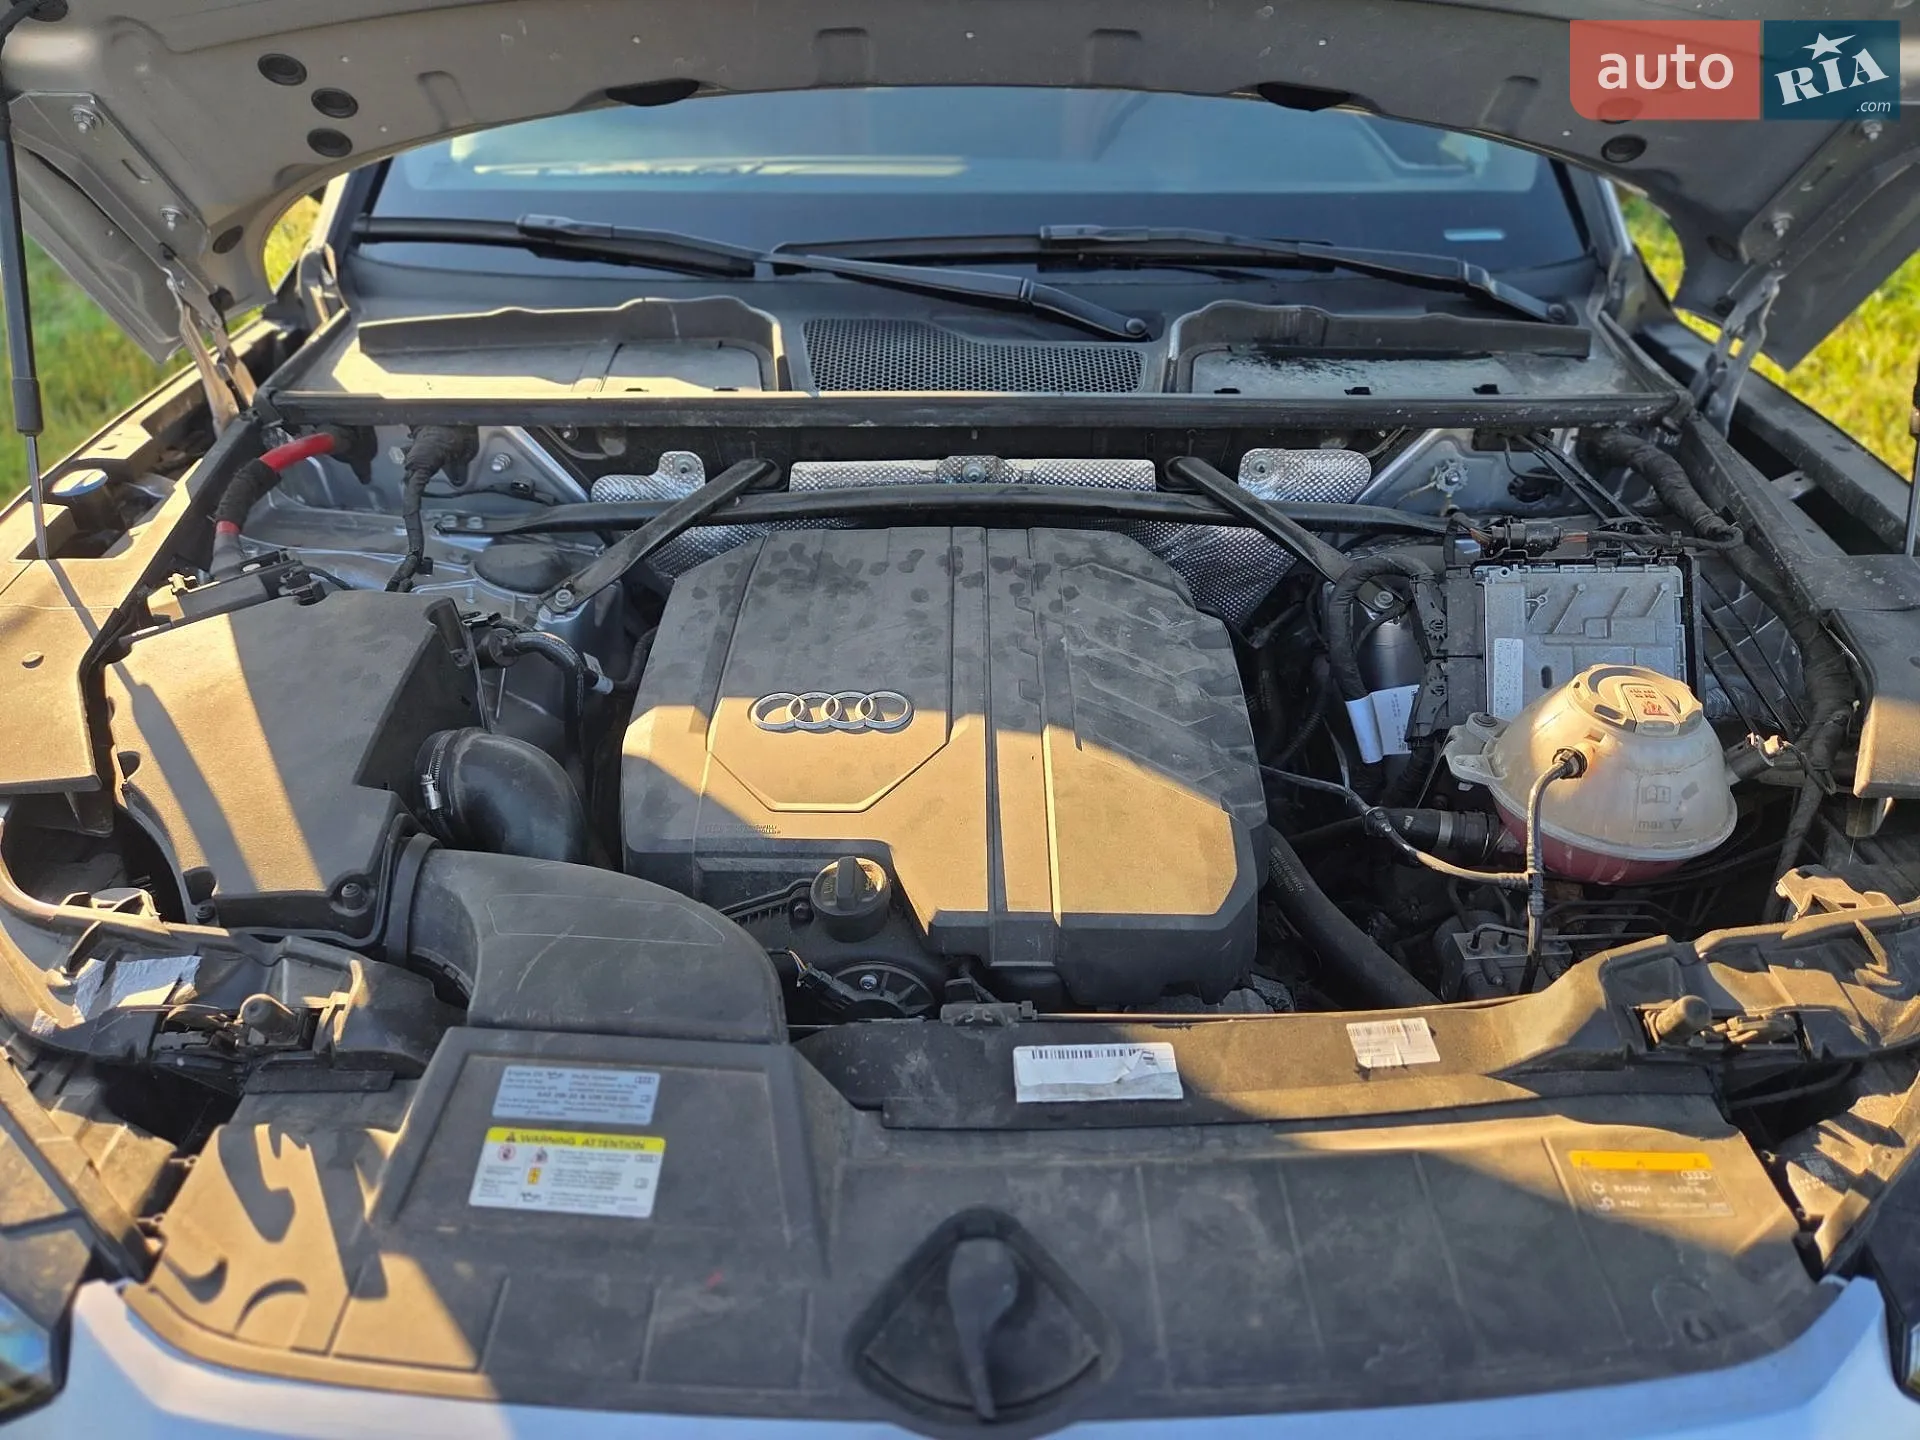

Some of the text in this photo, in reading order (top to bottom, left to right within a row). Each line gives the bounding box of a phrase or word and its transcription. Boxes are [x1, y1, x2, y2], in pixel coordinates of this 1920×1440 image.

[1638, 820, 1664, 830] max
[521, 1135, 646, 1150] WARNING ATTENTION
